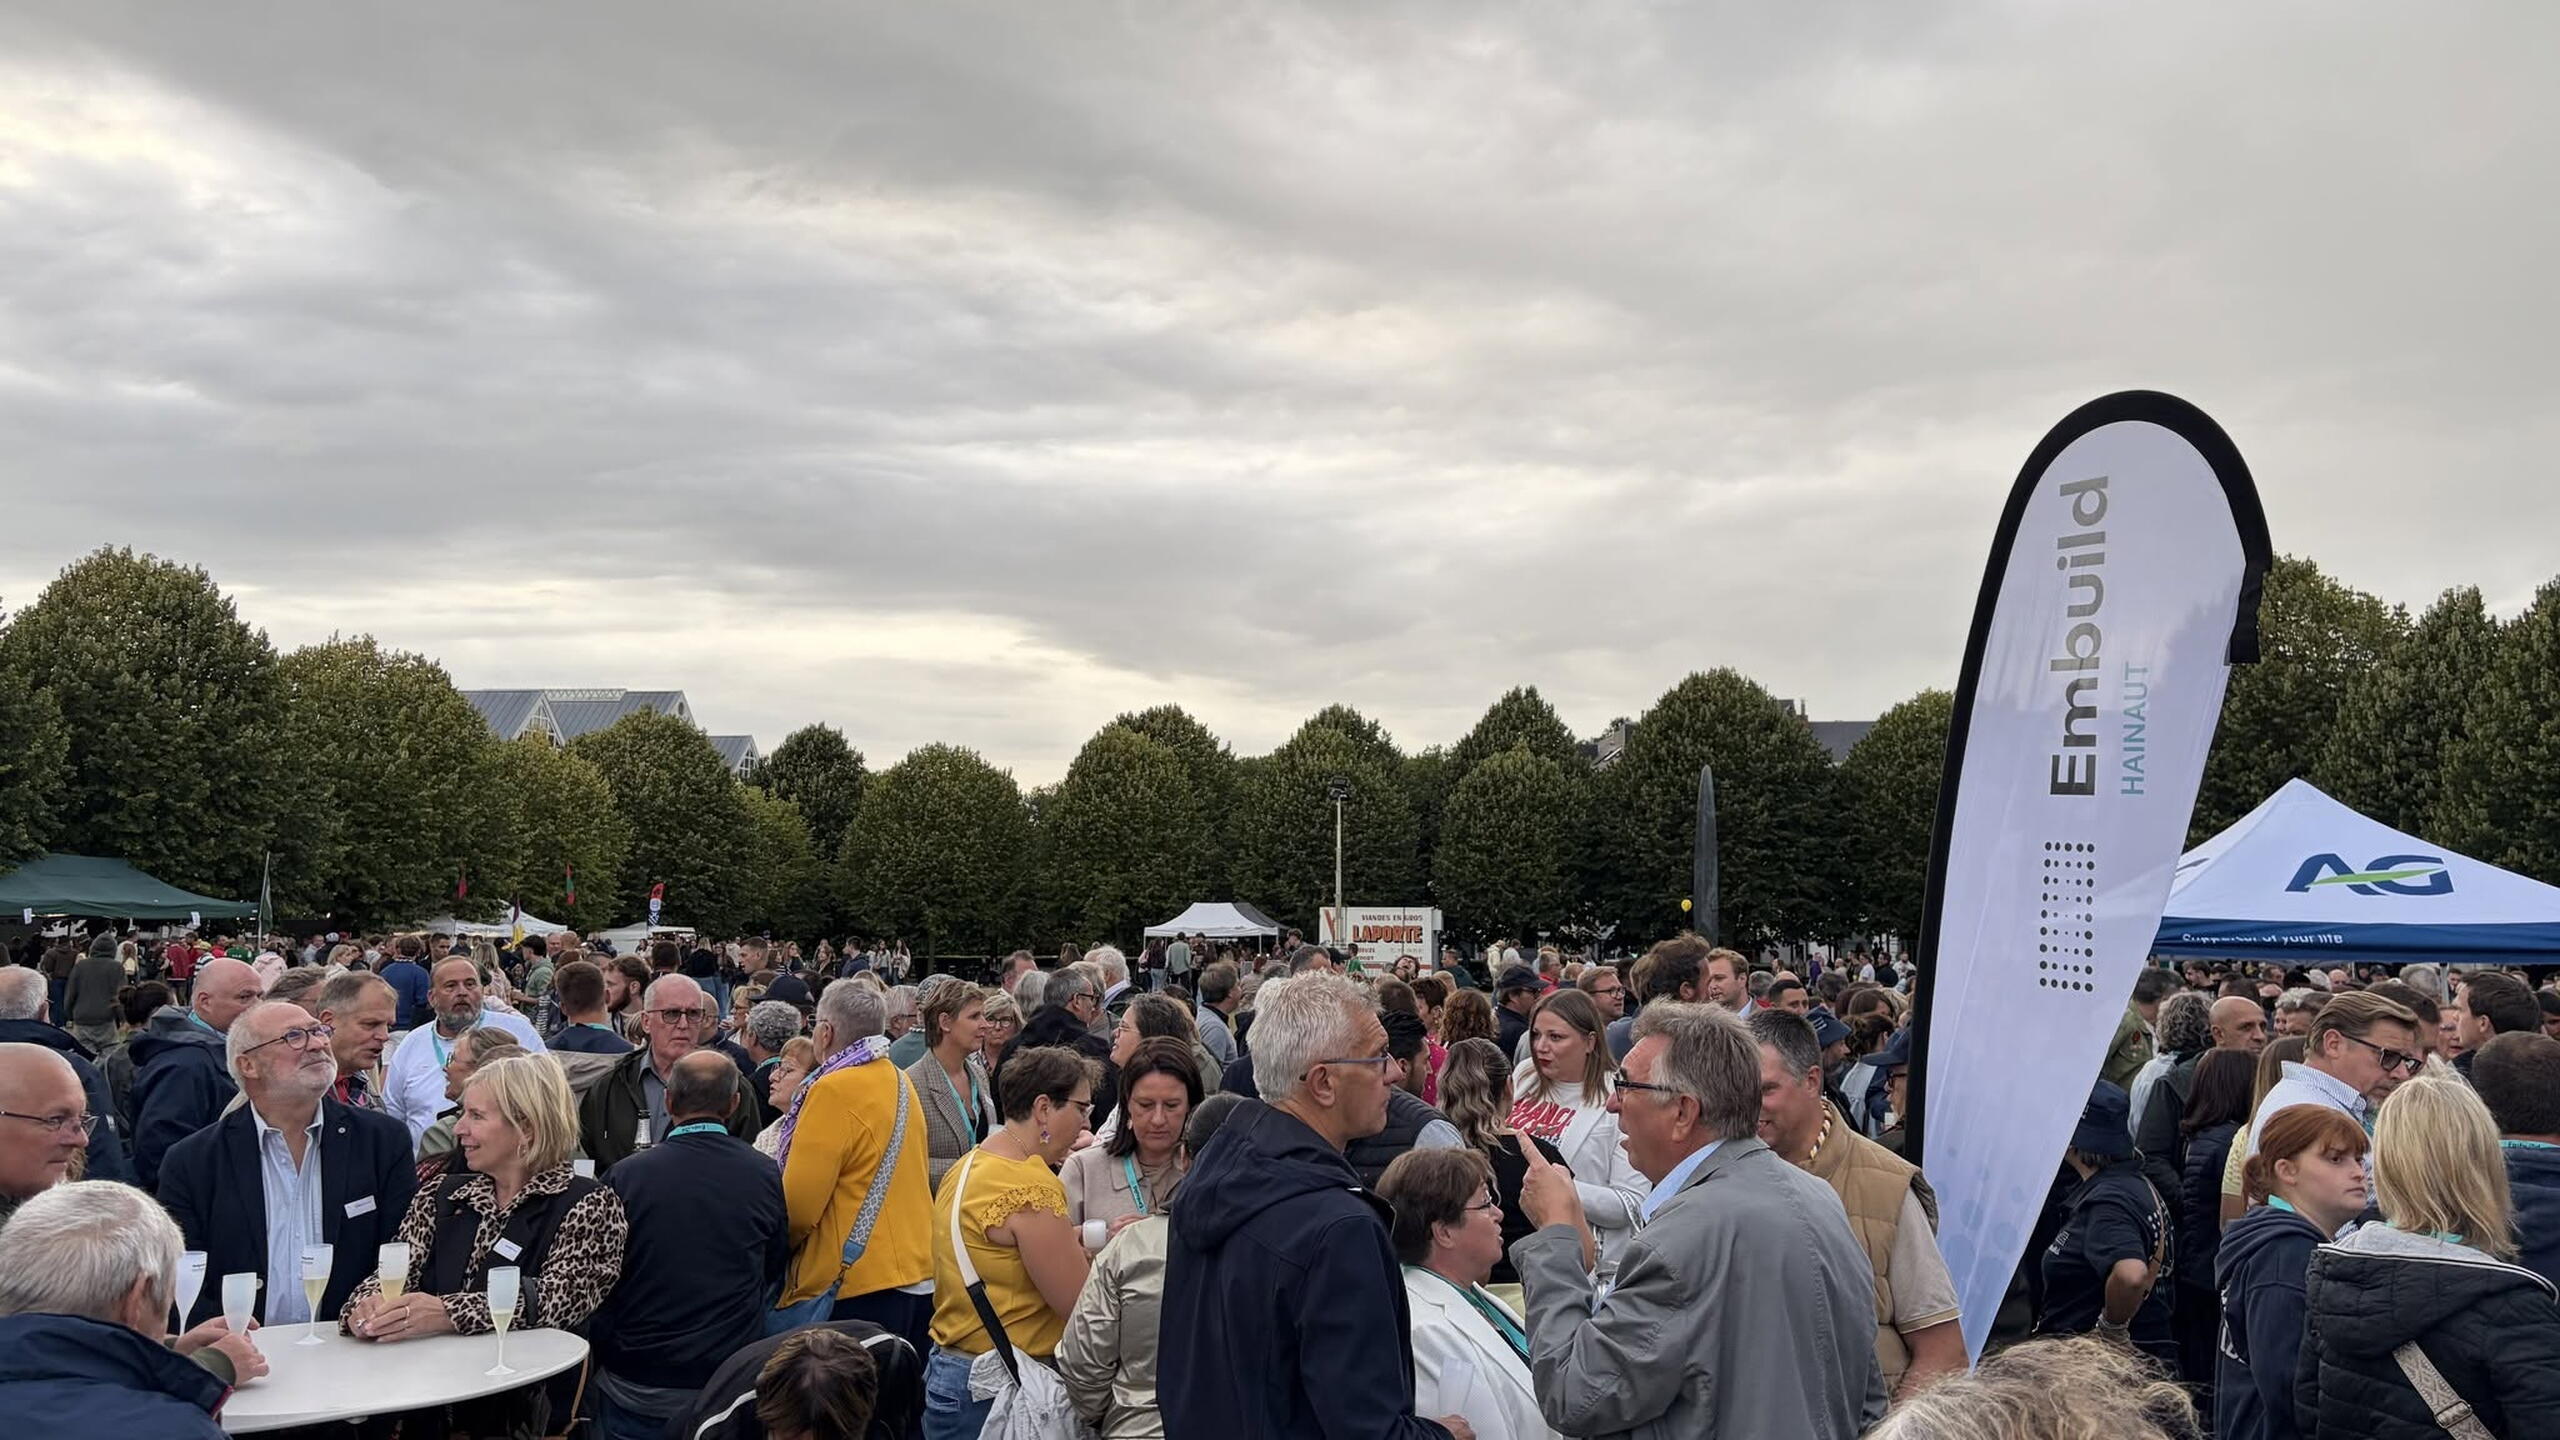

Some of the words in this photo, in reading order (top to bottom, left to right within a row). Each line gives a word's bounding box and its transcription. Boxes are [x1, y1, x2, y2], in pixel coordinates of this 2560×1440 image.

[2050, 475, 2109, 796] Embuild
[2121, 661, 2149, 796] HAINAUT
[2285, 853, 2454, 896] AG
[1353, 925, 1423, 943] LAPORTE
